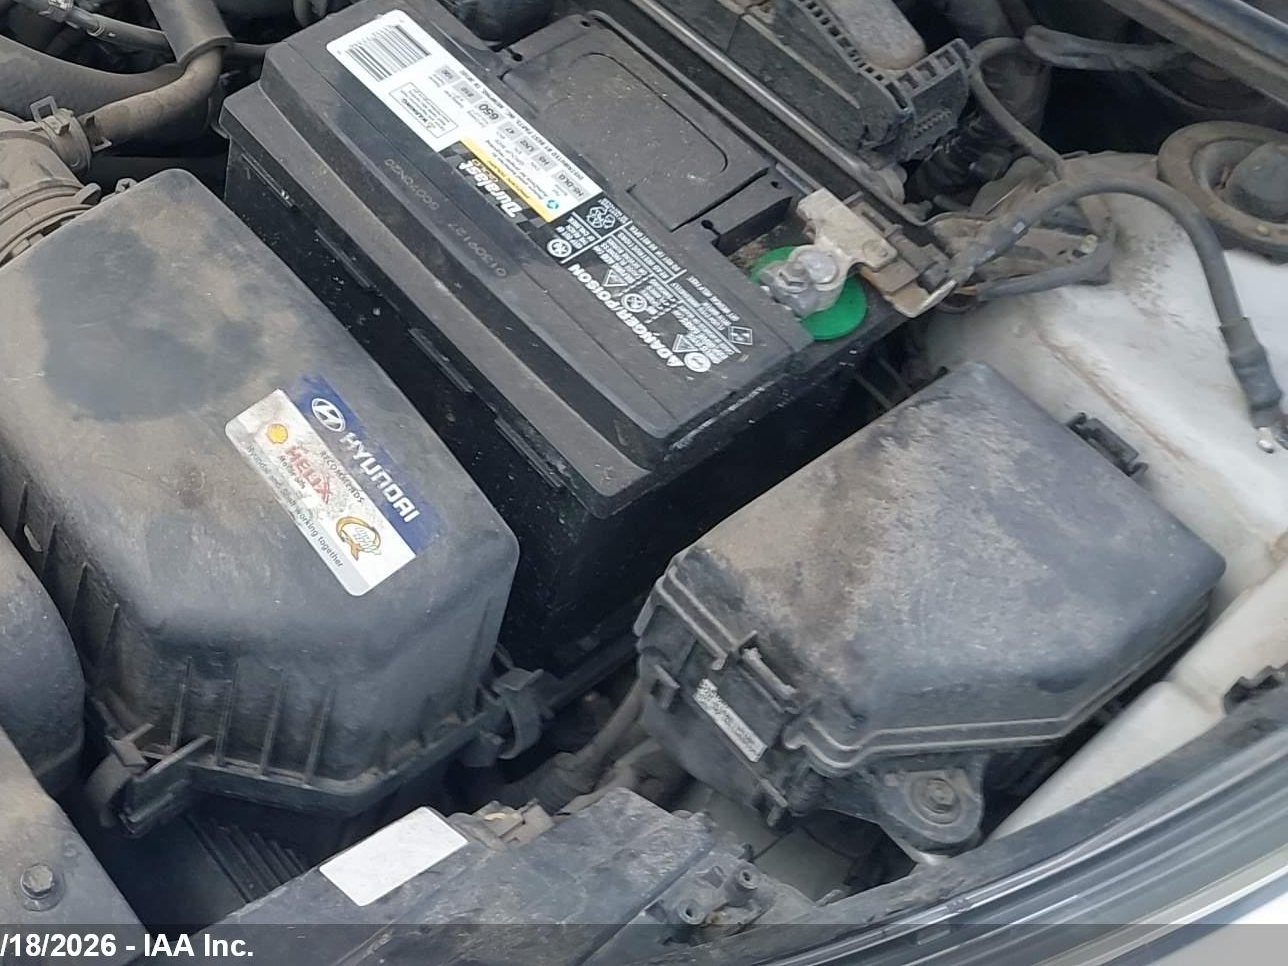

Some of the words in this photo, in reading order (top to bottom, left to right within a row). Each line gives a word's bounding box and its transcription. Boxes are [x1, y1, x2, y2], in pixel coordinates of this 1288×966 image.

[476, 101, 501, 121] 650
[455, 157, 526, 218] Duralast
[469, 156, 500, 183] GOLD
[566, 262, 675, 361] DANGER/POISON
[285, 444, 333, 505] HELIX
[339, 431, 421, 523] HYUNDAI
[290, 505, 321, 538] working
[314, 534, 346, 569] together
